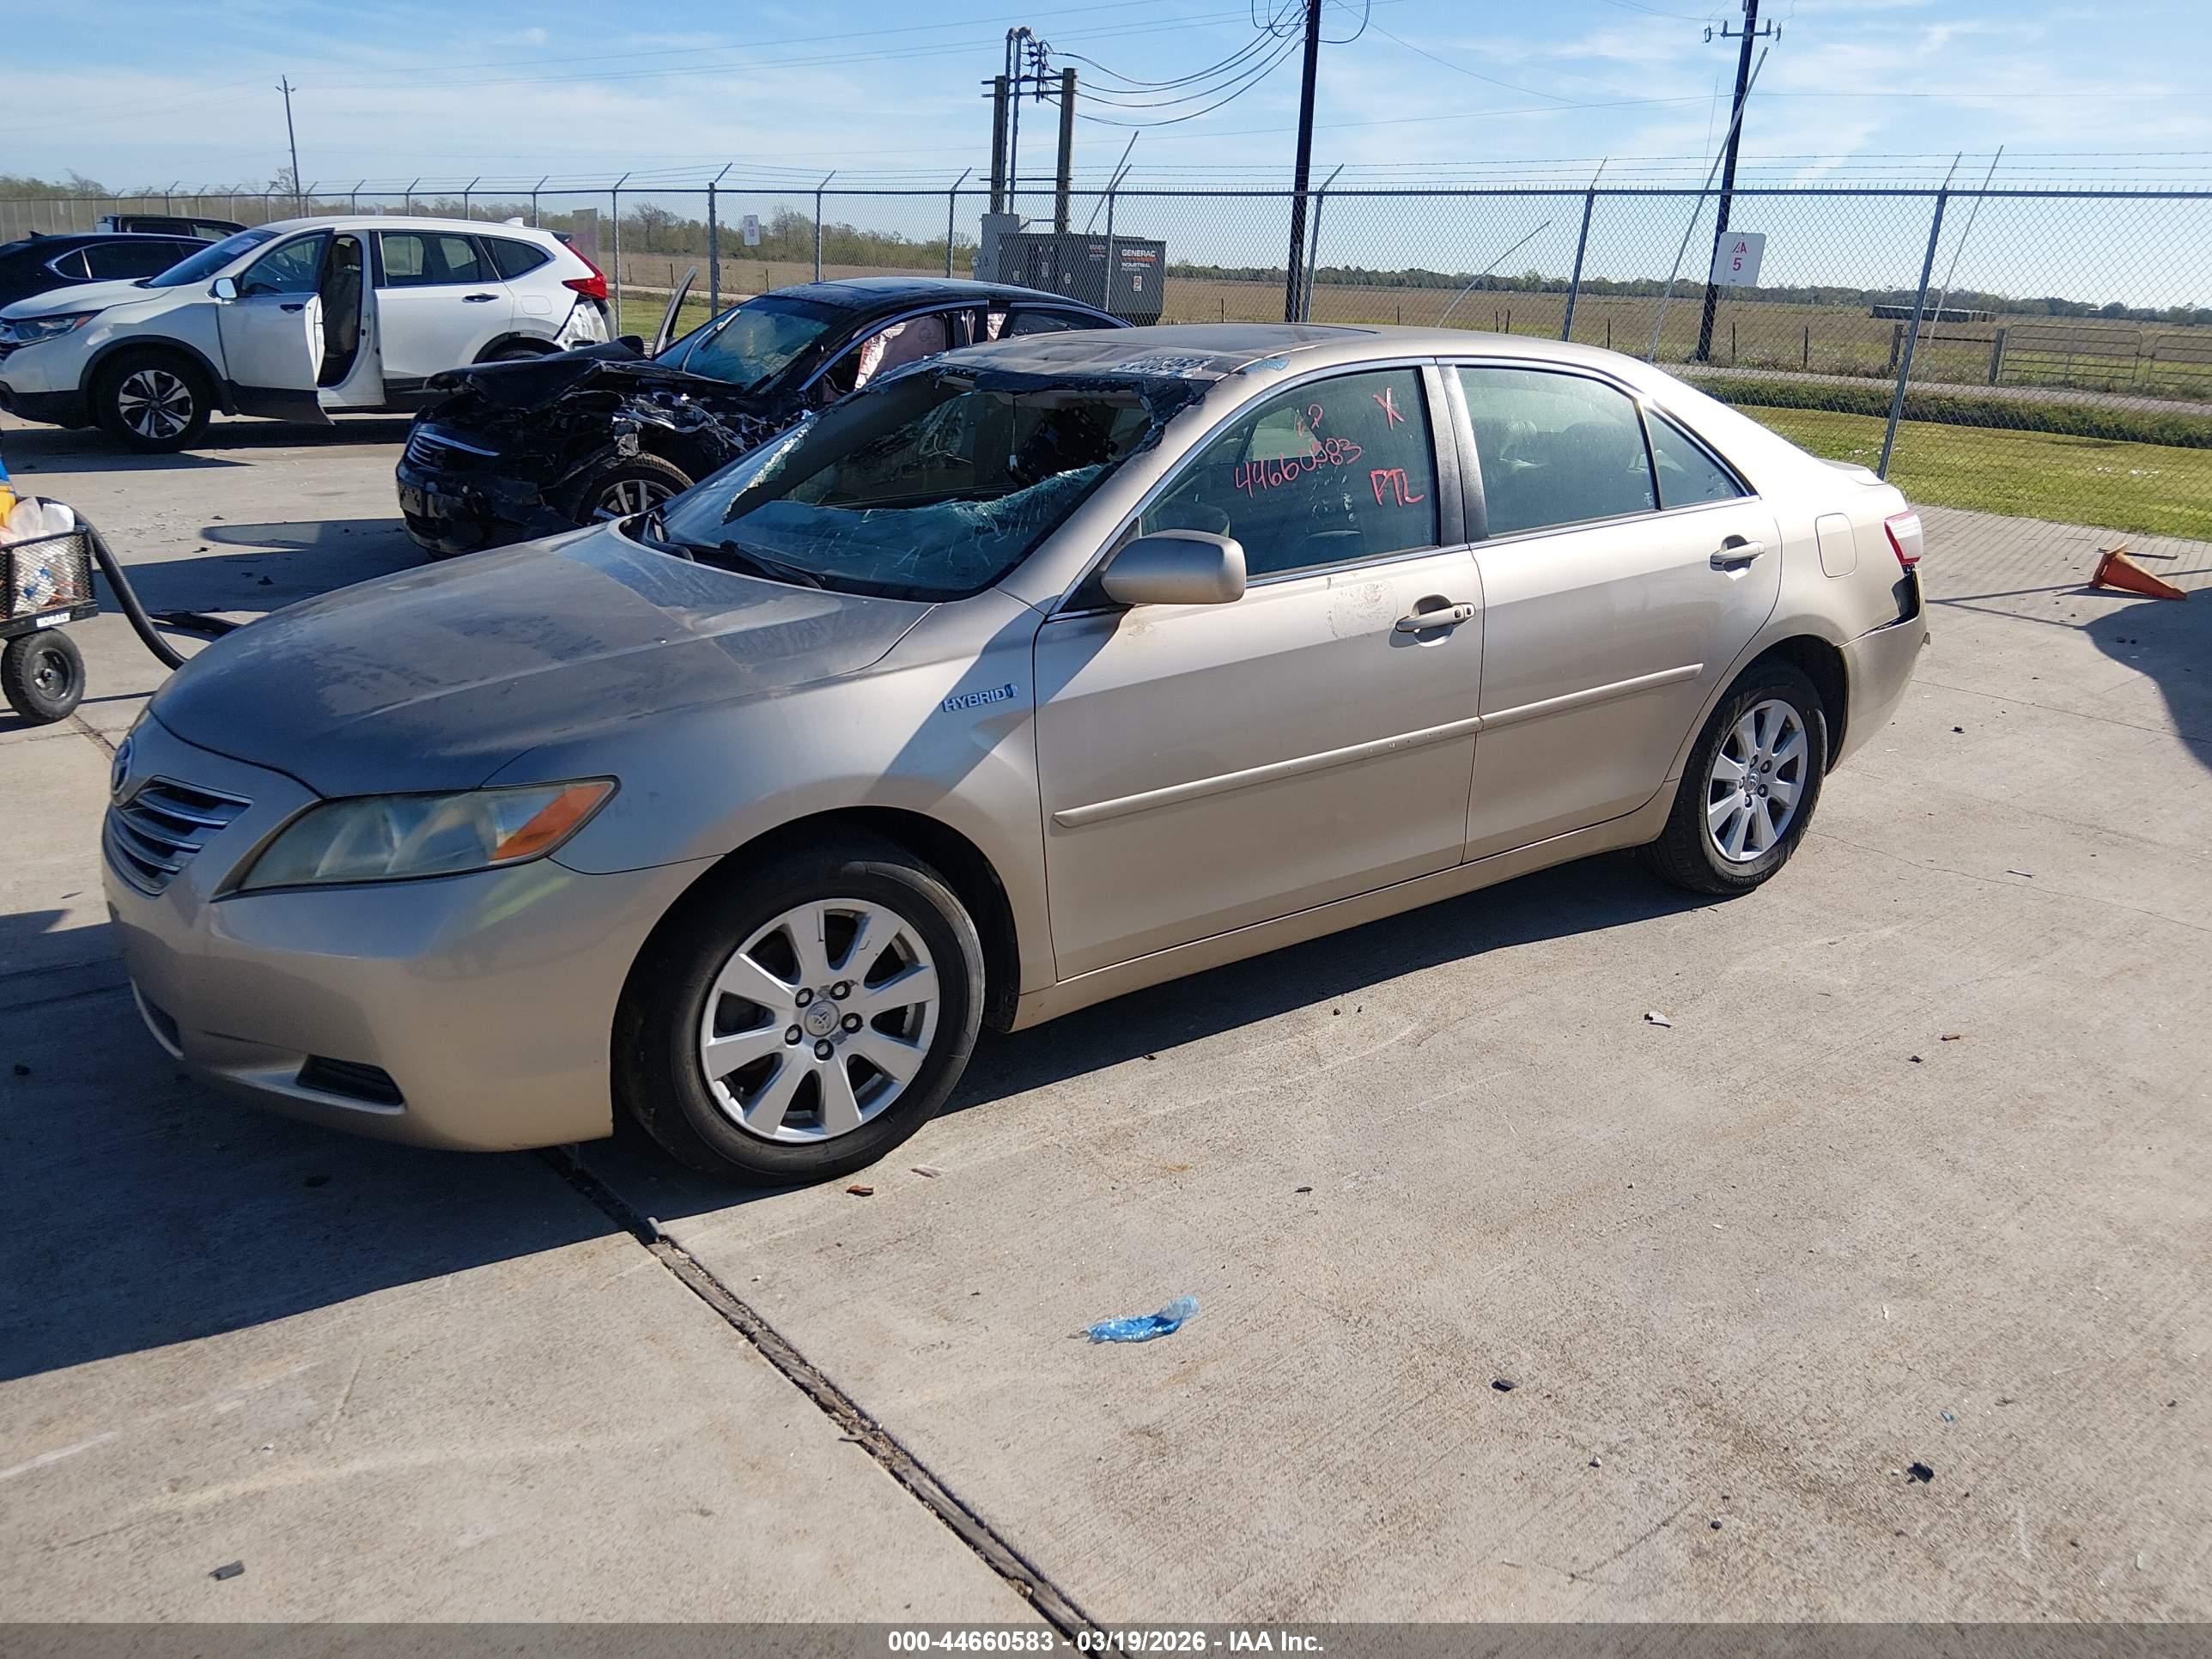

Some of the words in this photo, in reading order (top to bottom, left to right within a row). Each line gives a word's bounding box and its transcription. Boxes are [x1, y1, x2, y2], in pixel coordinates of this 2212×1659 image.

[1121, 248, 1156, 258] GENERAC
[1733, 257, 1742, 271] 5
[942, 688, 1008, 712] HYBRID
